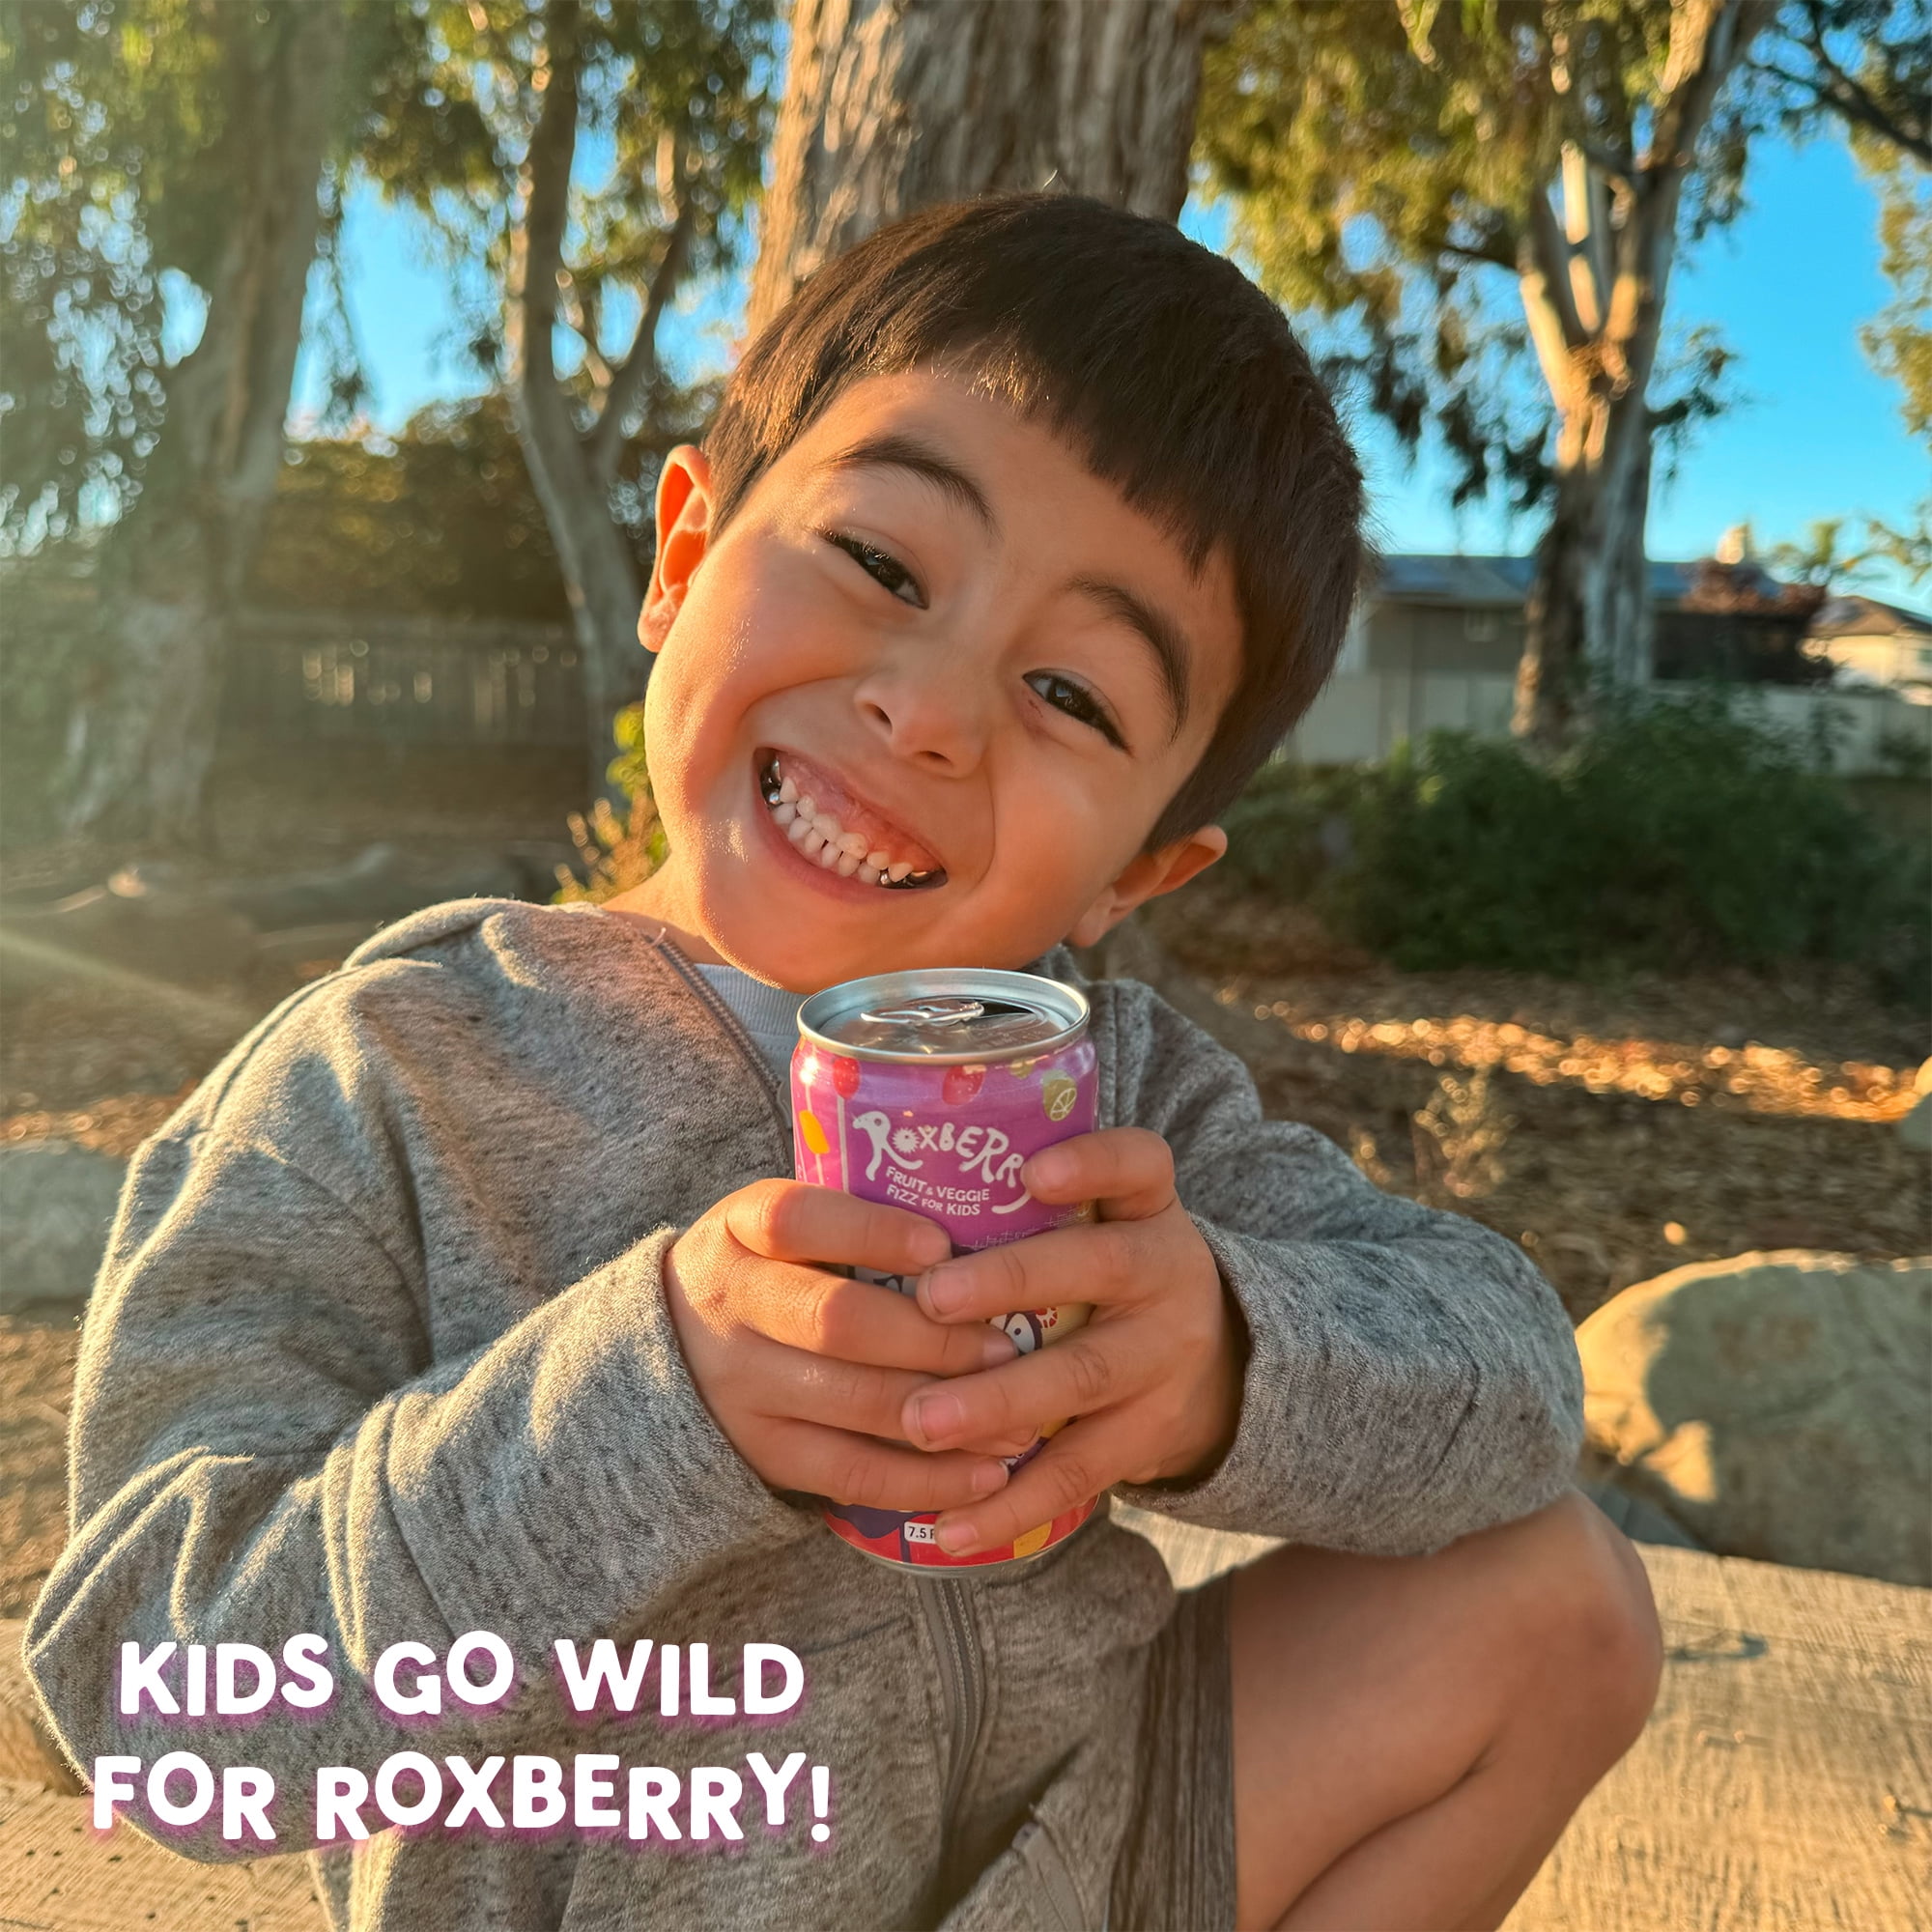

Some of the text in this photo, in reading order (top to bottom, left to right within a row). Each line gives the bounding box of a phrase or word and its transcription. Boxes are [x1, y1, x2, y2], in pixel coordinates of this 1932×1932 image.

[886, 1165, 990, 1202] FRUIT & VEGGIE
[887, 1184, 980, 1216] FIZZ FOR KIDS
[908, 1526, 926, 1538] 7.5
